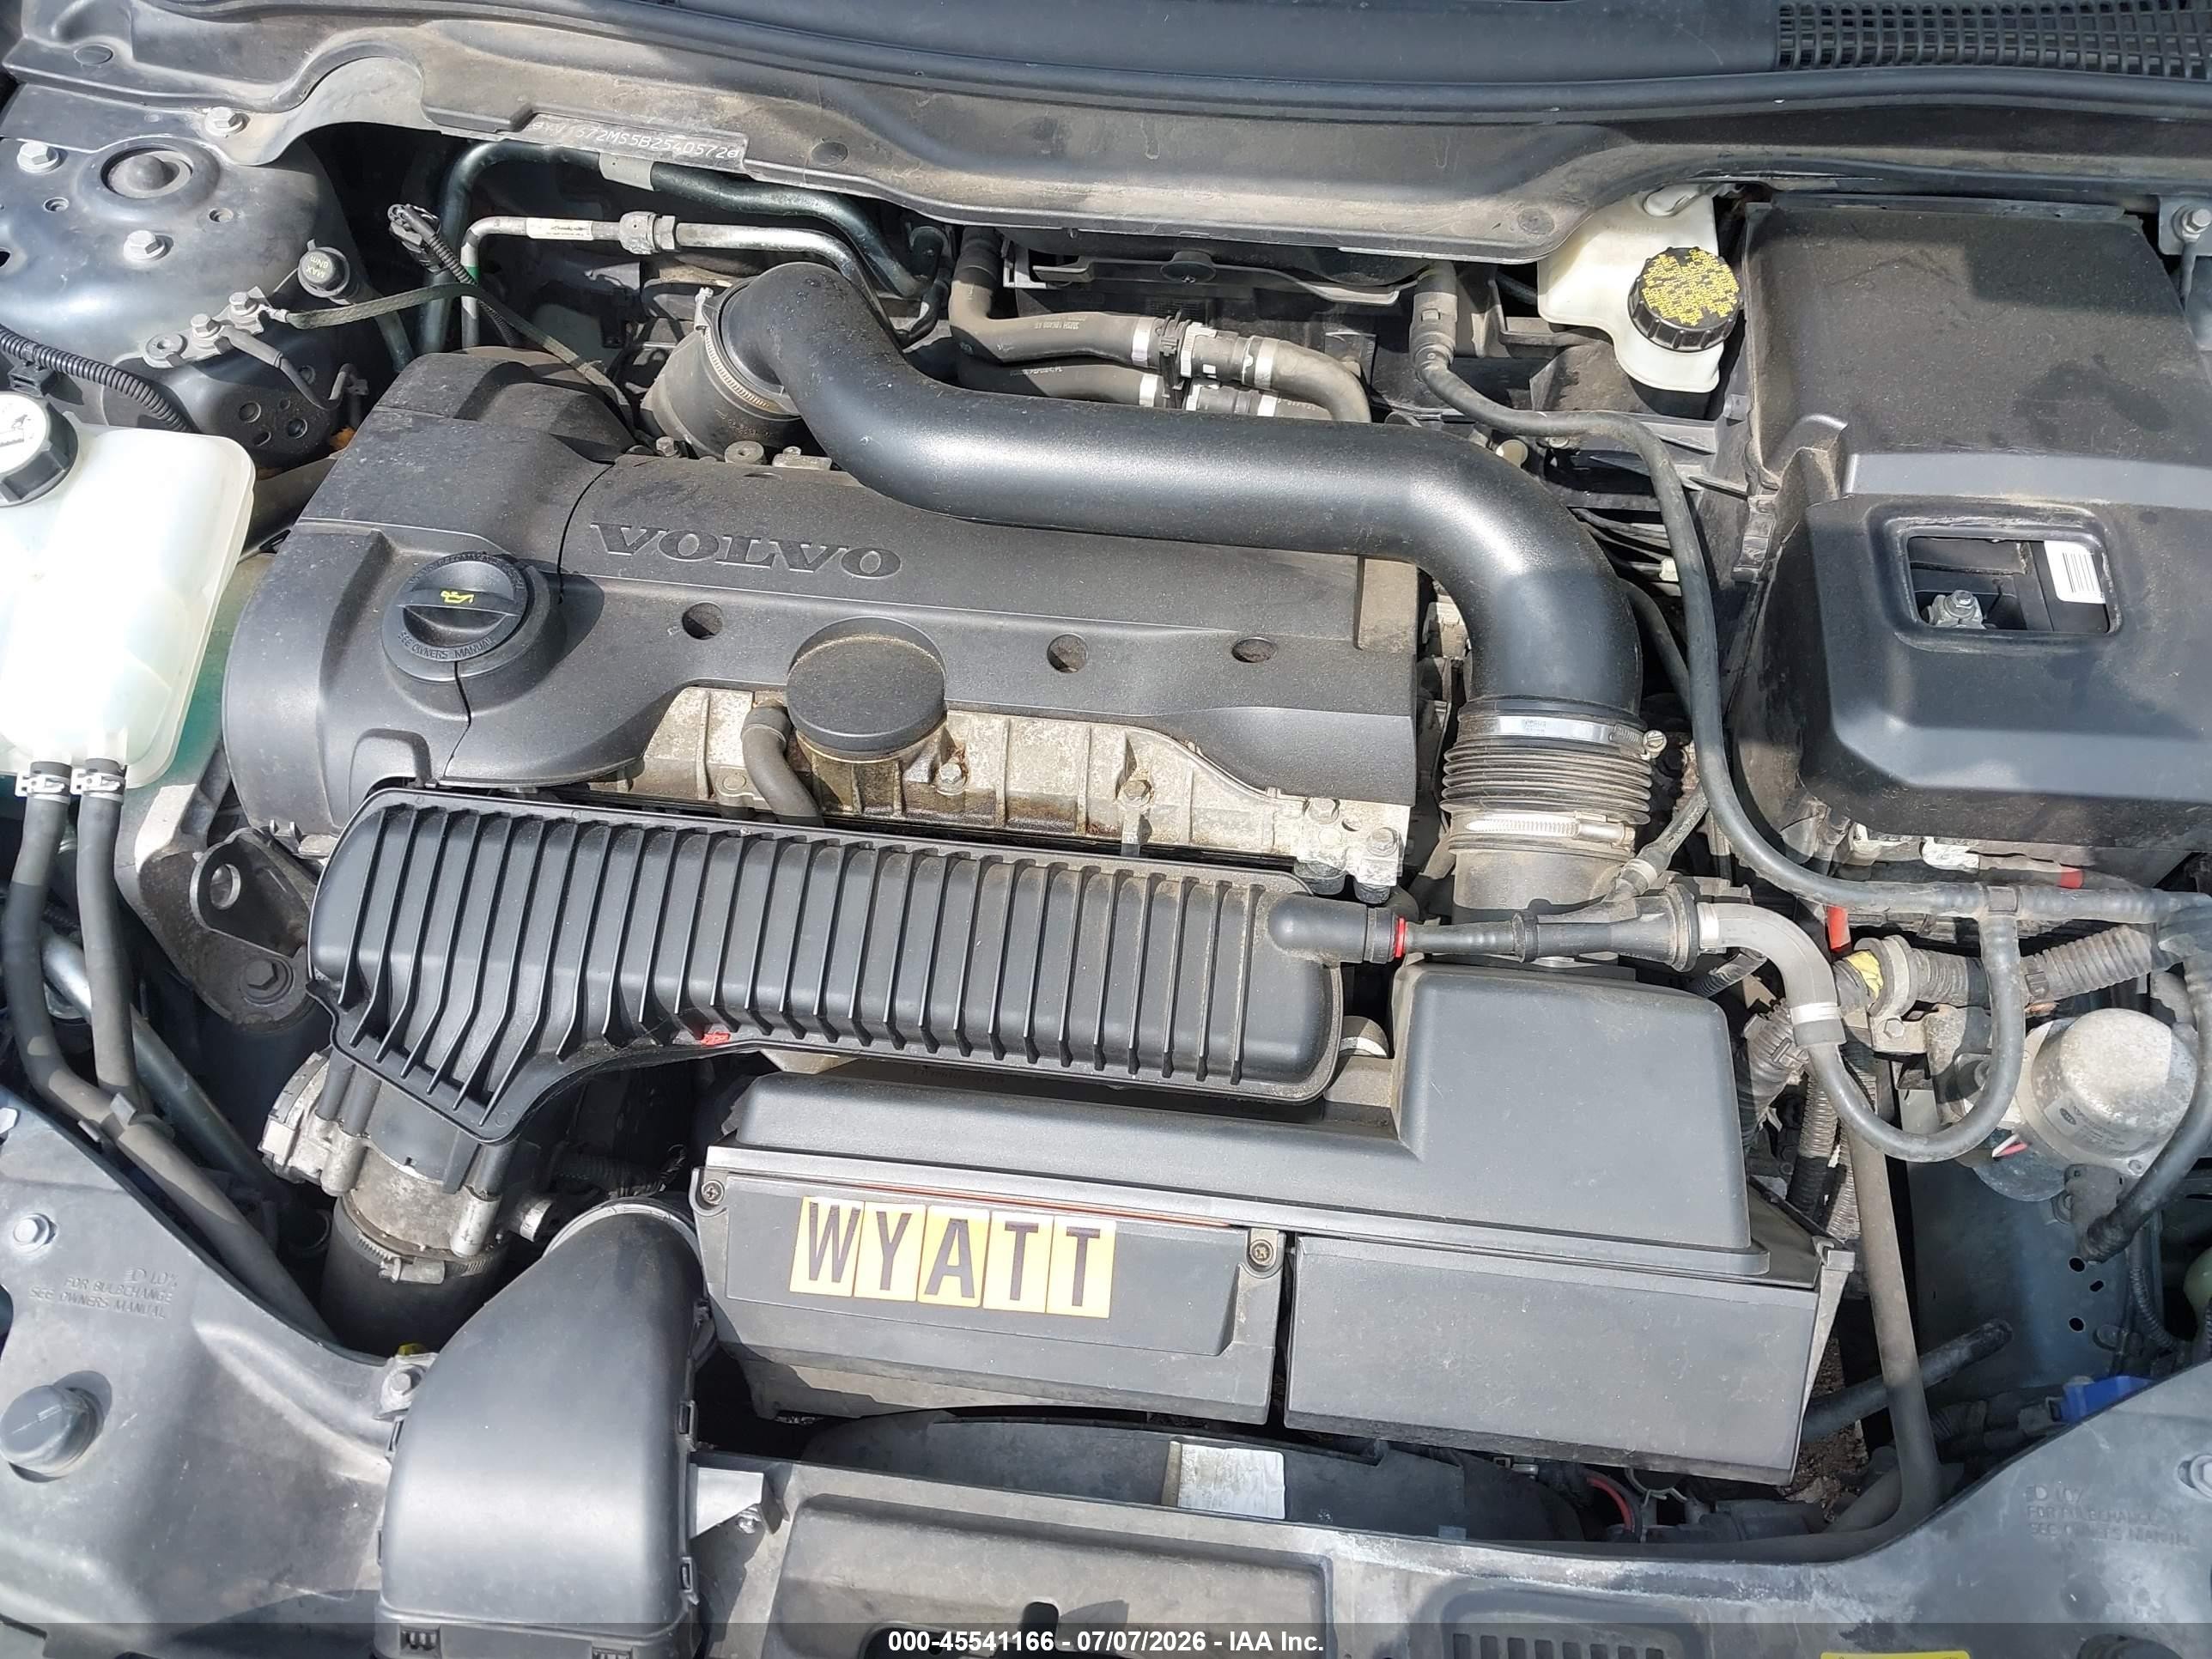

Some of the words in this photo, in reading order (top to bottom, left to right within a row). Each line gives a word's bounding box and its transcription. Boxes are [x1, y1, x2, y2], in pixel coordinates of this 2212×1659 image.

[590, 521, 902, 580] VOLVO
[453, 636, 496, 659] MANUAL
[808, 1200, 1101, 1308] WYATT
